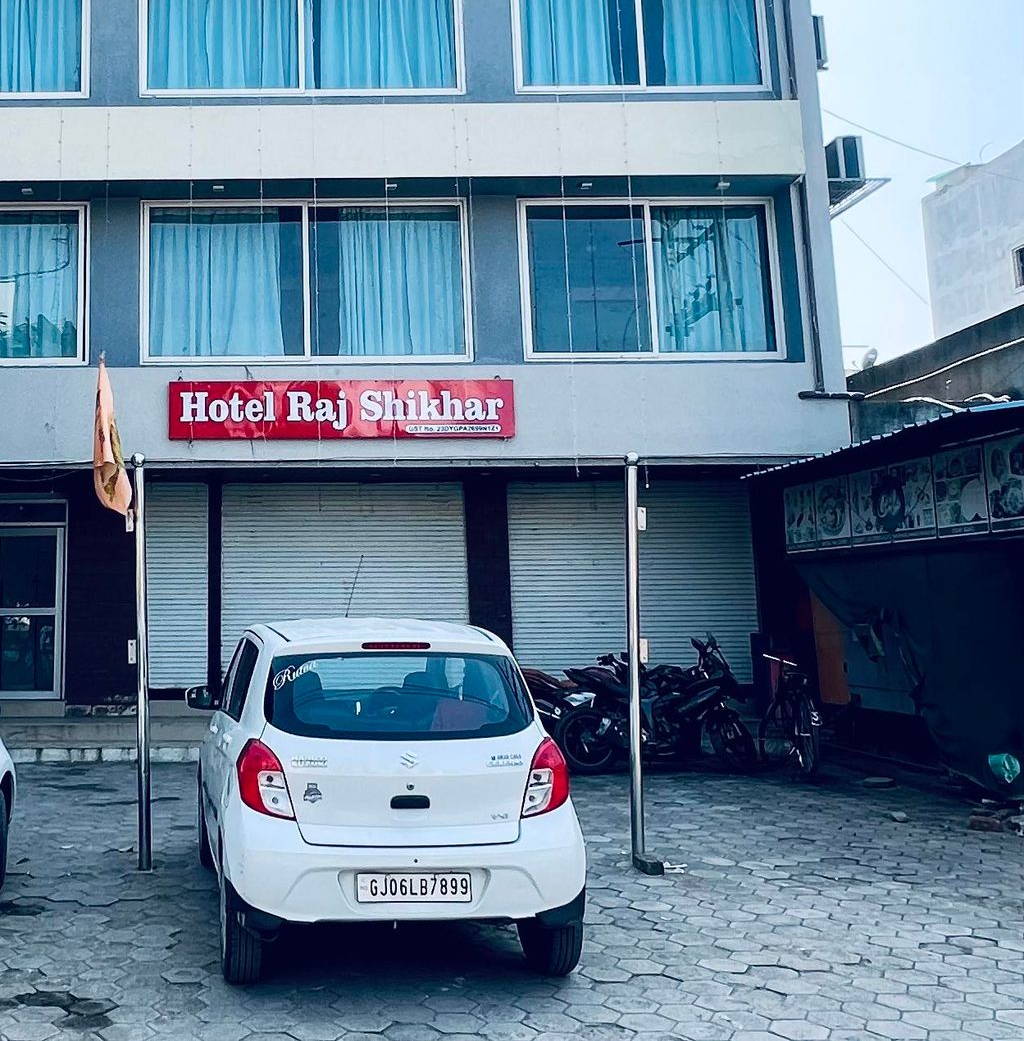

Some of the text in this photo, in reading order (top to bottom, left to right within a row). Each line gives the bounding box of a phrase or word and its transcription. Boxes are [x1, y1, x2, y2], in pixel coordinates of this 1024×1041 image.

[180, 390, 504, 430] Hotel Raj Shikhar
[370, 877, 468, 896] GJ06LB7899
